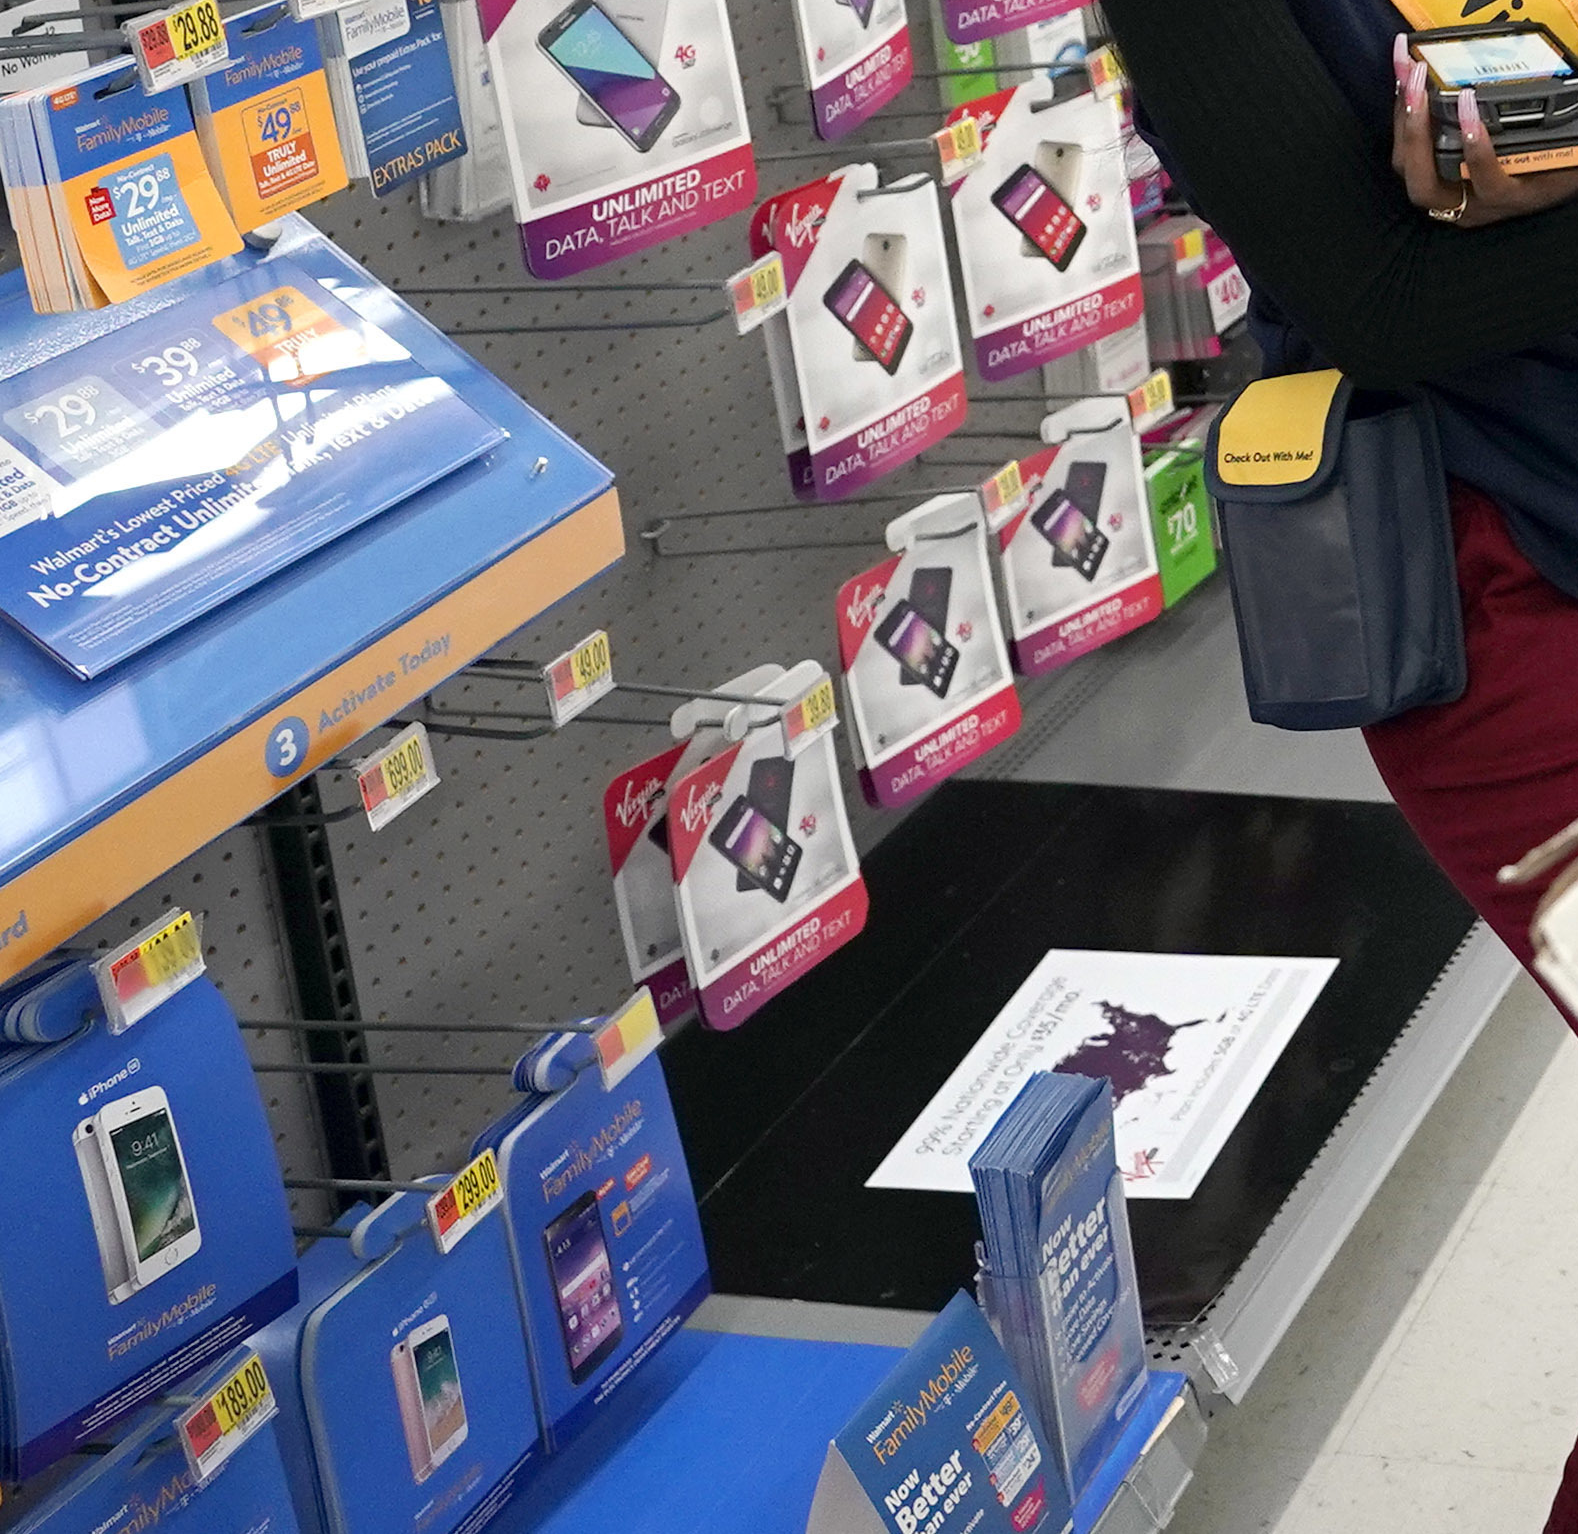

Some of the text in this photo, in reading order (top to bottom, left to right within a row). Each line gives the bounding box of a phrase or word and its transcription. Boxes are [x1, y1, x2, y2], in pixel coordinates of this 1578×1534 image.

[173, 3, 219, 49] $29.88
[675, 44, 696, 62] 4G
[76, 107, 169, 152] FamilyMobile
[267, 141, 297, 162] TRULY
[263, 151, 306, 177] Unlimited
[373, 129, 461, 189] EXTRAS PACK
[121, 205, 180, 236] Unlimited
[592, 169, 700, 222] UNLIMITED
[607, 210, 652, 239] TALK
[657, 190, 699, 219] AND
[703, 170, 746, 203] TEXT
[1022, 295, 1103, 337] UNLIMITED
[328, 423, 373, 460] Text
[1224, 450, 1314, 464] Check Out With Me!
[31, 473, 226, 576] Walmart's Lowest Priced
[27, 522, 180, 607] No-Contract
[317, 632, 452, 733] Activate Today
[275, 729, 298, 766] 3
[750, 916, 820, 975] UNLIMITED
[87, 1068, 129, 1100] iPhone
[915, 975, 1067, 1156] 99% Nationwide Coverage
[131, 1133, 159, 1157] 9:41
[942, 1088, 1003, 1157] Starting
[543, 1099, 643, 1203] FamilyMobile
[457, 1156, 496, 1207] $299.00
[108, 1283, 217, 1359] FamilyMobile
[217, 1362, 266, 1421] $189.00
[874, 1344, 974, 1465] FamilyMobile
[883, 1469, 920, 1510] Now
[894, 1449, 965, 1534] Better
